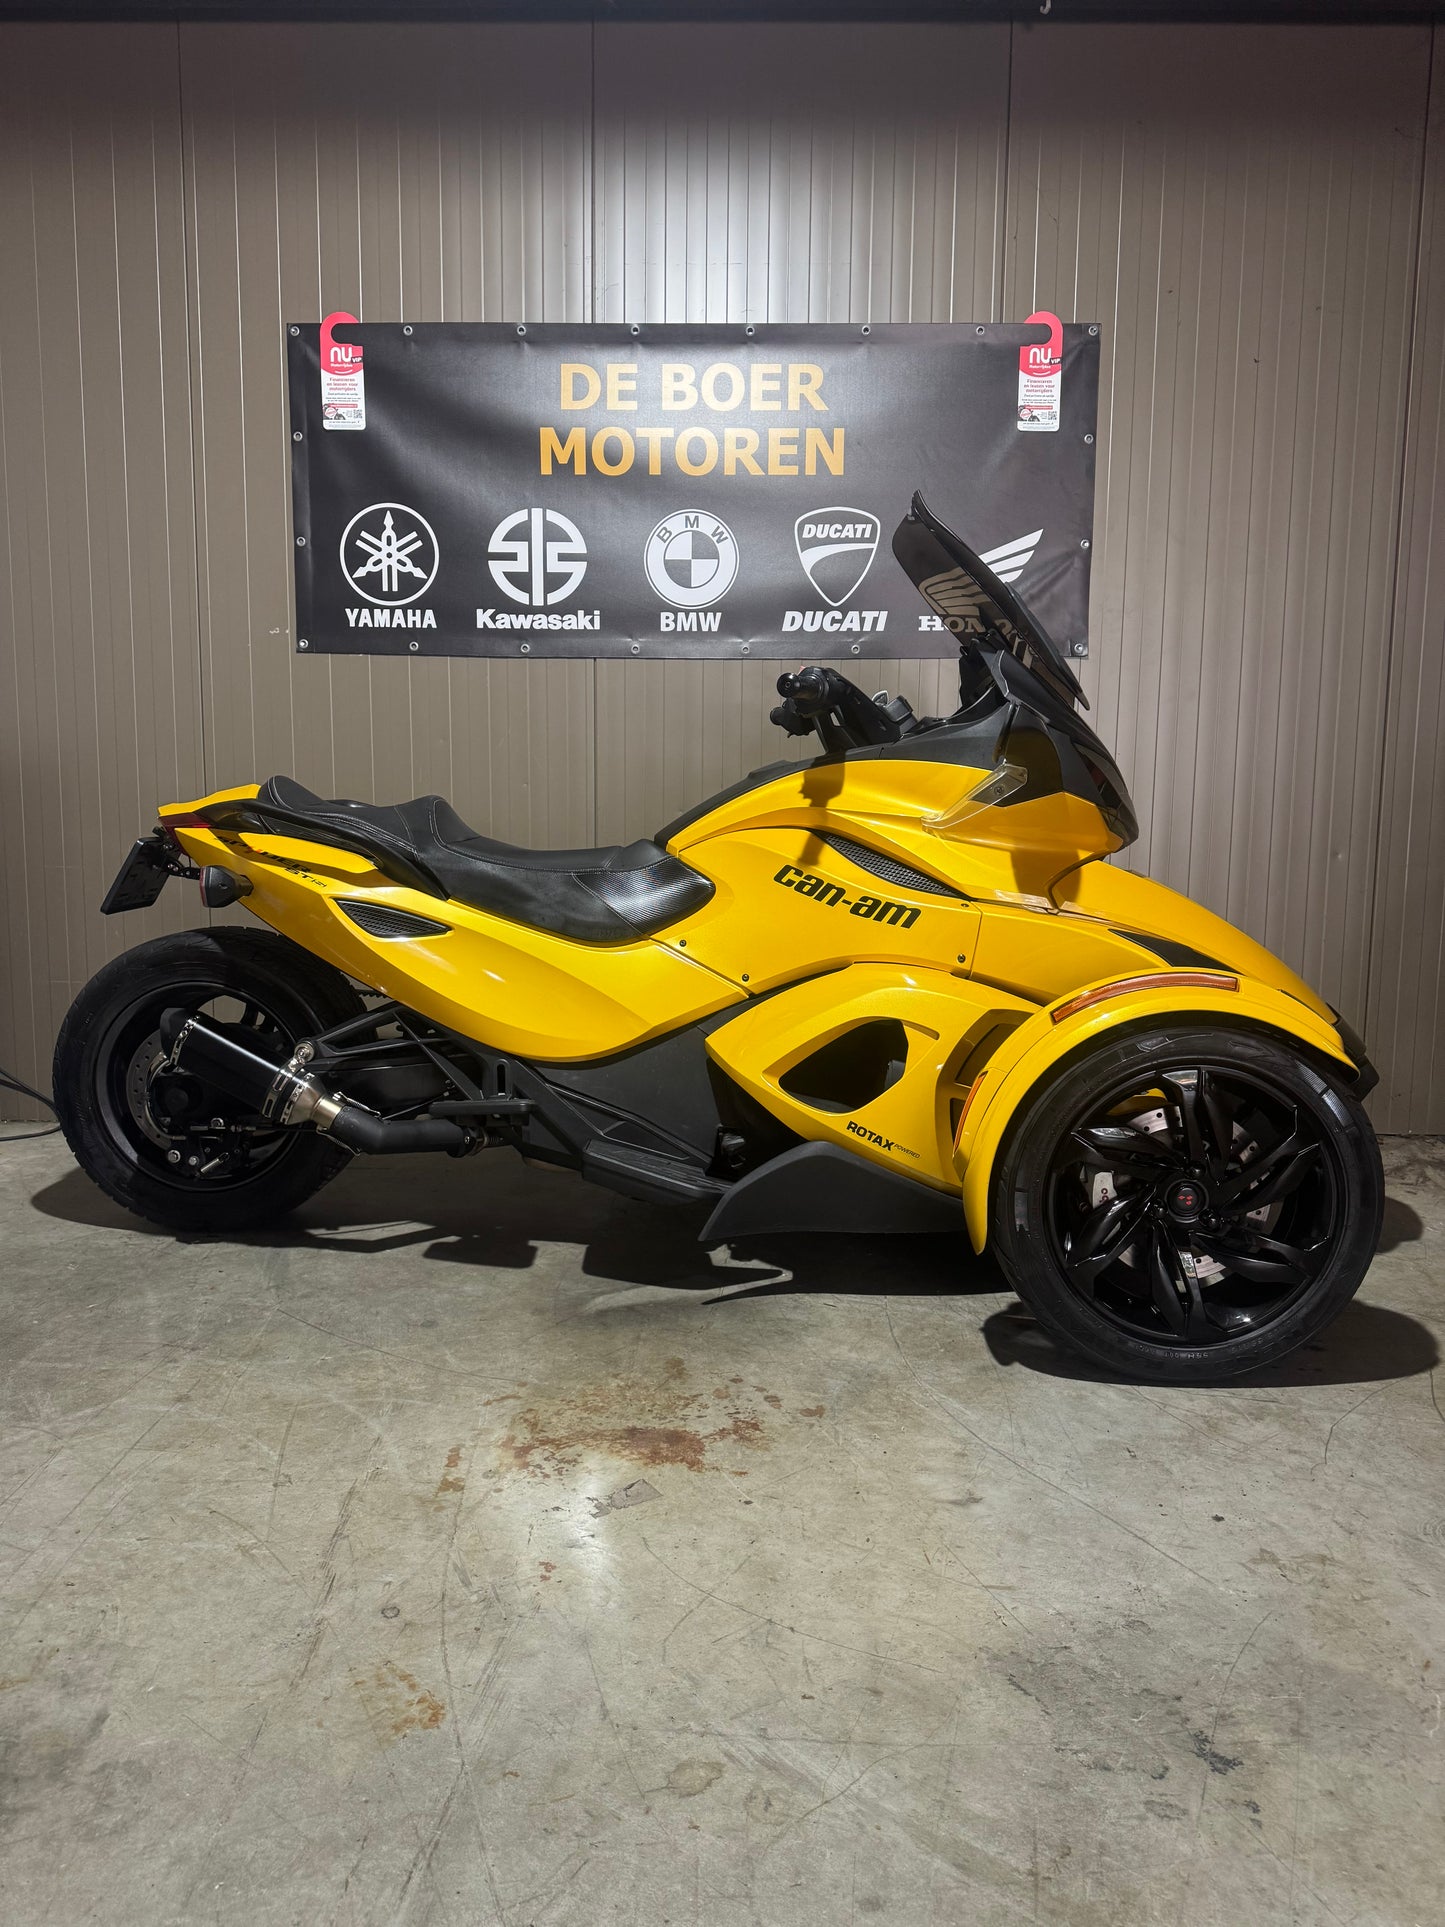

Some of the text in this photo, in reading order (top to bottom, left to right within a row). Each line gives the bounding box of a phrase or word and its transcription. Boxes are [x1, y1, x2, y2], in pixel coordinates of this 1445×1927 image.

[560, 362, 829, 412] DE BOER
[539, 426, 845, 476] MOTOREN
[802, 523, 872, 539] DUCATI
[345, 608, 437, 628] YAMAHA
[476, 608, 600, 630] Kawasaki
[660, 612, 722, 632] BMW
[781, 611, 888, 632] DUCATI
[773, 864, 922, 929] can-am
[846, 1120, 921, 1159] ROTAX POWERED
